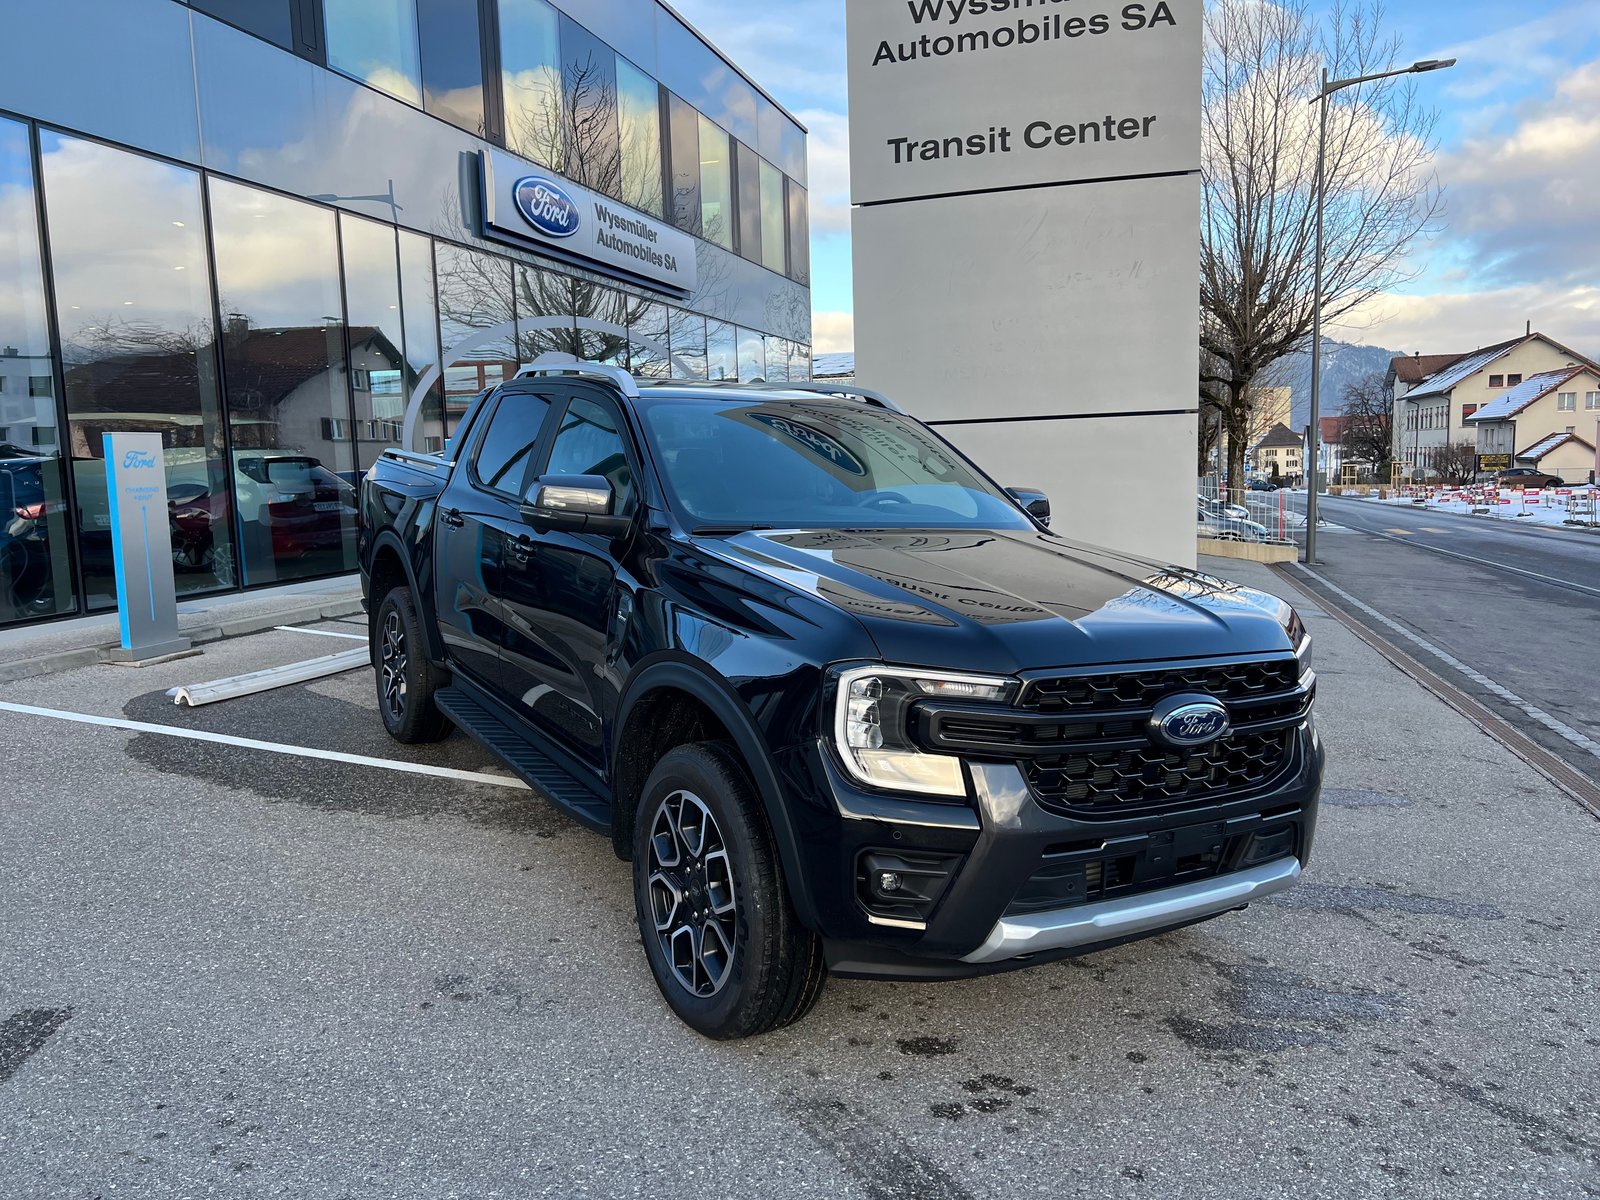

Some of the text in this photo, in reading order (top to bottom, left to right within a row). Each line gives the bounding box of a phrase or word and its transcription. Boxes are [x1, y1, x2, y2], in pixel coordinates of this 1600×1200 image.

[908, 0, 1071, 24] Wyss
[872, 2, 1177, 66] Automobiles SA
[887, 115, 1157, 164] Transit Center
[530, 183, 570, 228] Ford
[594, 202, 658, 243] Wyssmüller
[596, 228, 678, 272] Automobiles SA
[123, 450, 156, 469] Ford
[1179, 712, 1217, 736] Ford
